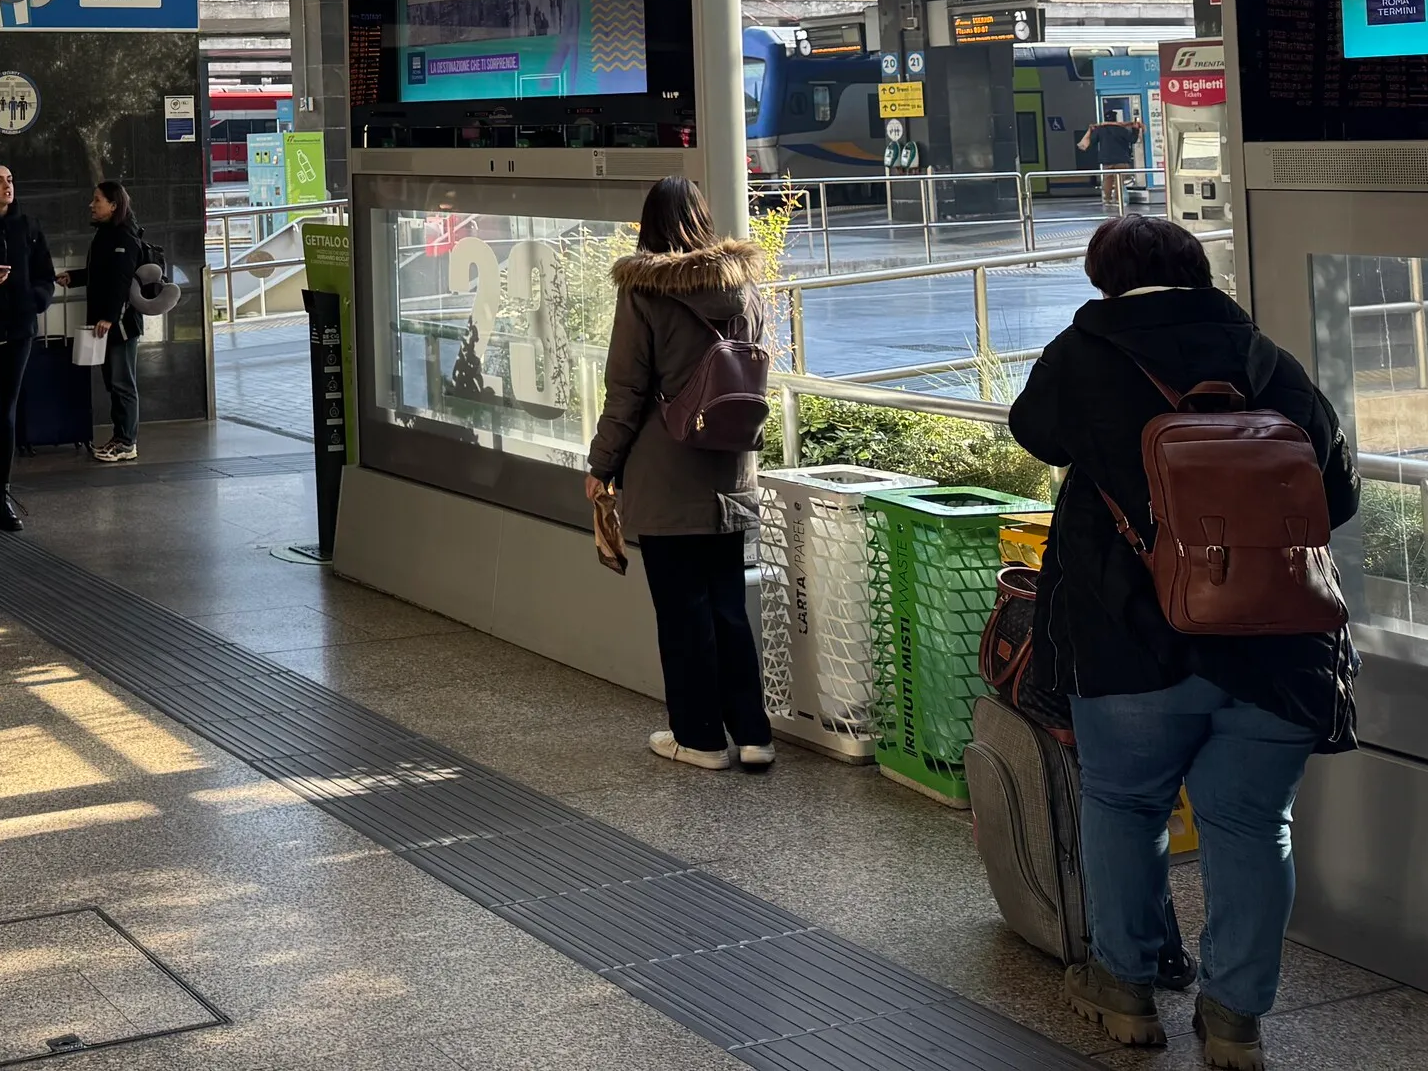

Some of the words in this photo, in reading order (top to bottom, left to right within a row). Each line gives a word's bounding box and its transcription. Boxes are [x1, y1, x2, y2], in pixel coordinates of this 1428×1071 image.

[1014, 10, 1028, 21] 21
[1377, 6, 1417, 16] TERMINI
[436, 59, 470, 73] DESTINAZIONE
[470, 58, 481, 71] CHE
[481, 58, 487, 71] TI
[884, 58, 896, 68] 20
[910, 57, 921, 67] 21
[1183, 79, 1223, 91] Biglietti
[305, 234, 342, 248] GETTALO
